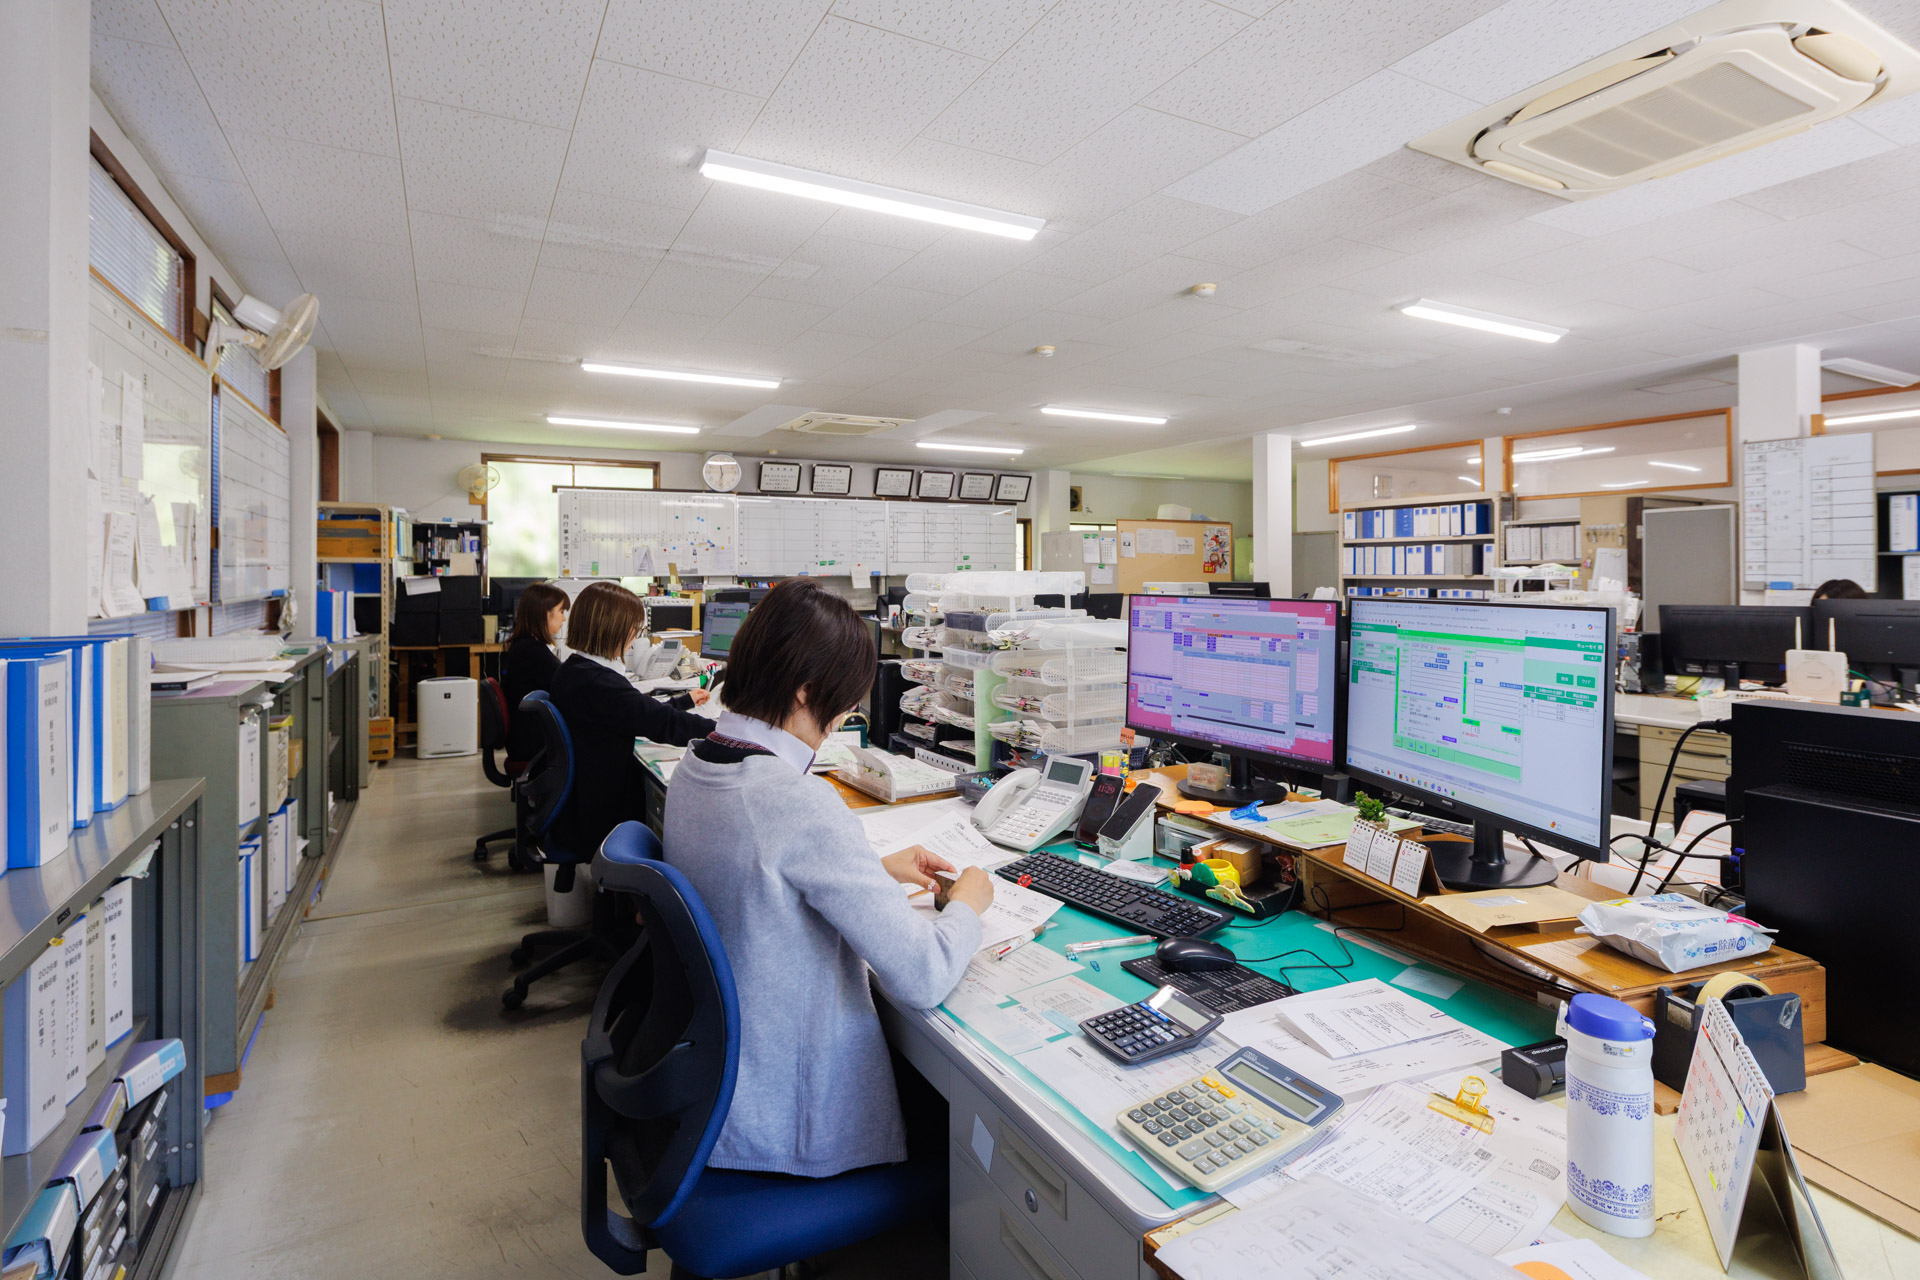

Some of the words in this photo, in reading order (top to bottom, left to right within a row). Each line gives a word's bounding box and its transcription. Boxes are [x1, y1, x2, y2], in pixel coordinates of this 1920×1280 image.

[86, 920, 100, 935] 026年
[1705, 1010, 1712, 1029] 5
[1532, 1044, 1566, 1055] ScanSnap
